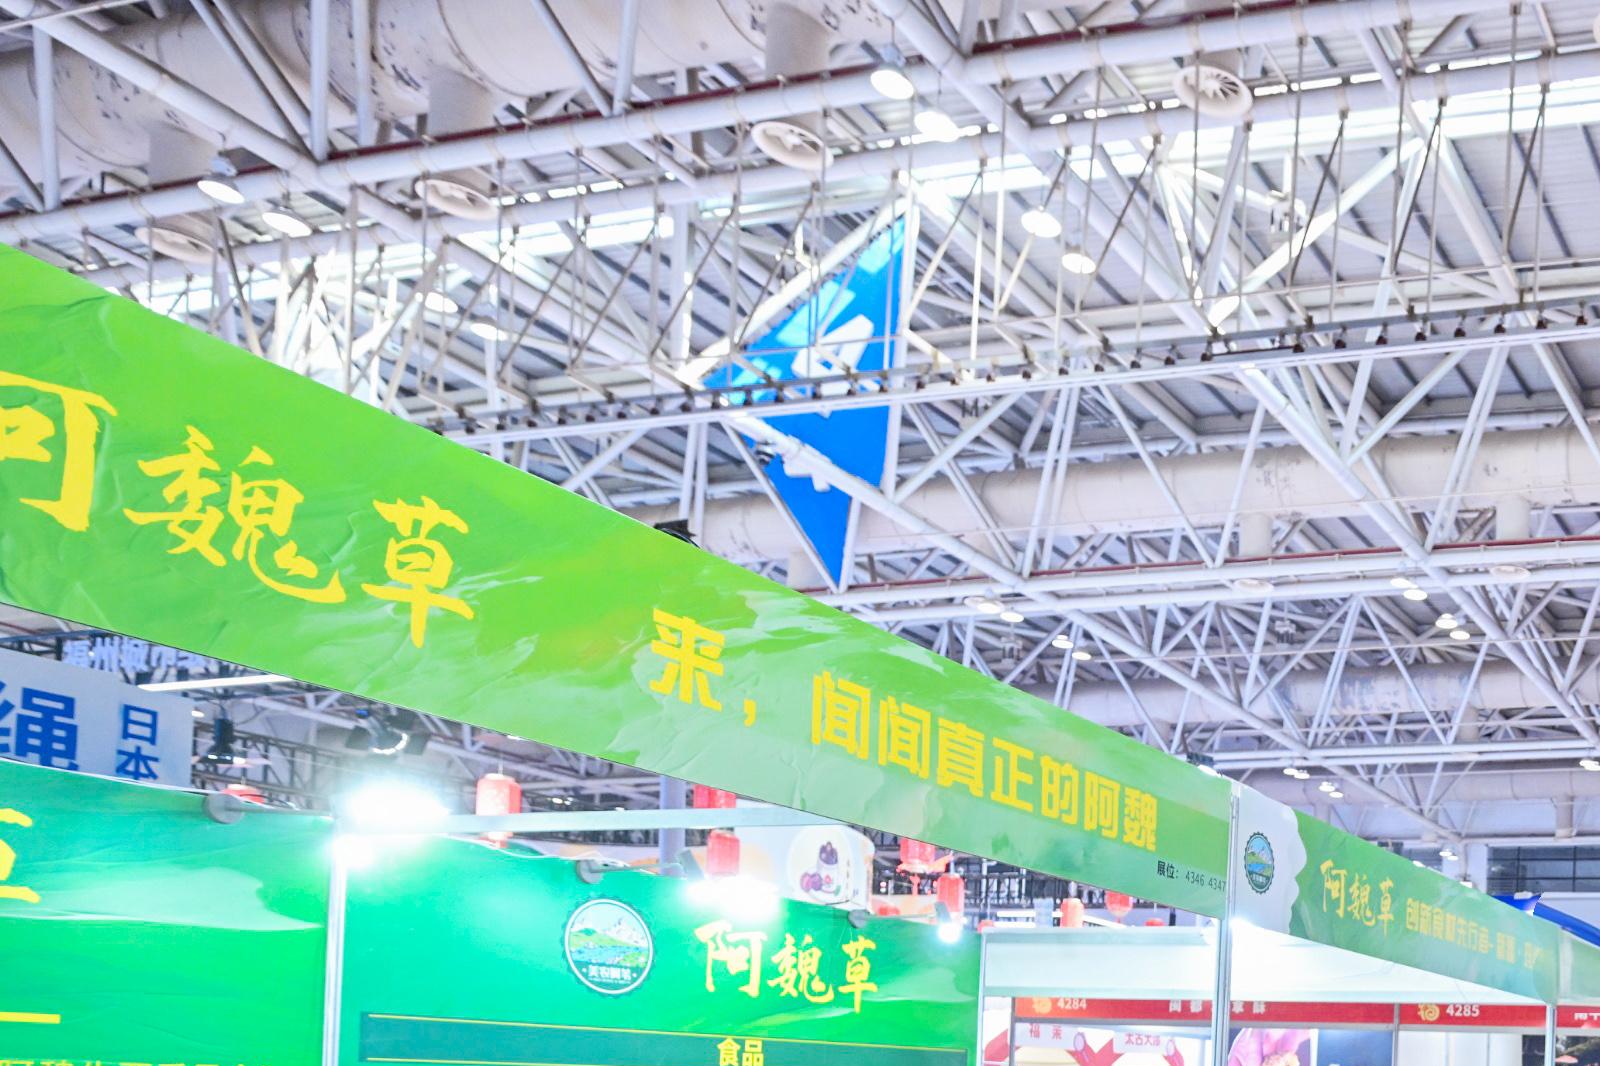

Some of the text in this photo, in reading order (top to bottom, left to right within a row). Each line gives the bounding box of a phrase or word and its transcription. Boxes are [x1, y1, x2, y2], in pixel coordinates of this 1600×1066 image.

[1185, 870, 1205, 888] 4346
[1208, 876, 1227, 893] 4347
[1320, 859, 1394, 937] 阿魏草
[693, 919, 878, 1014] 阿魏草
[1446, 1004, 1480, 1019] 4285
